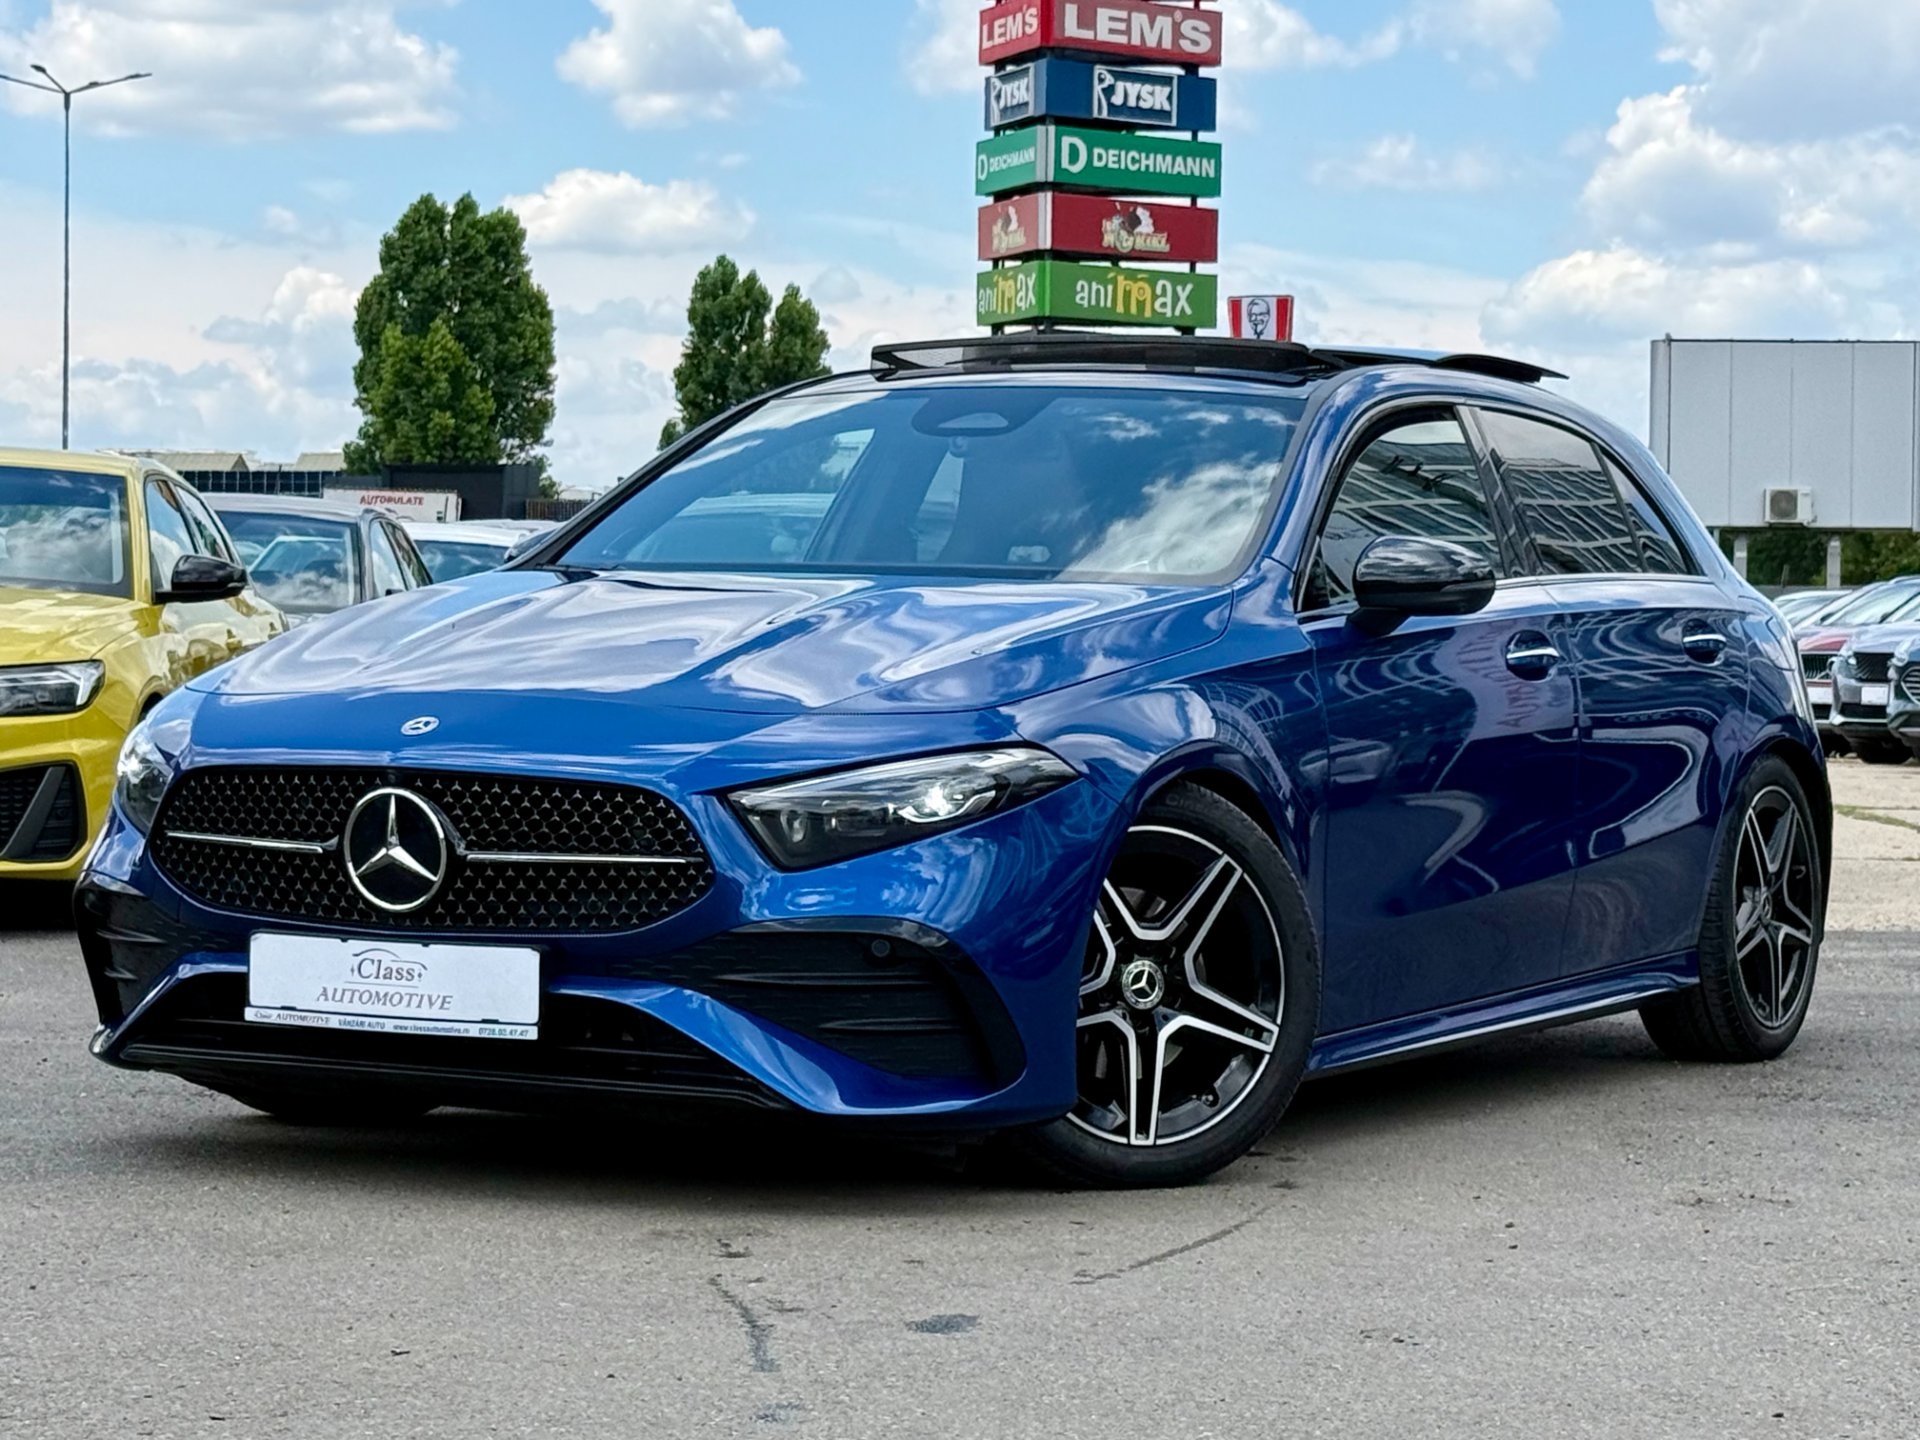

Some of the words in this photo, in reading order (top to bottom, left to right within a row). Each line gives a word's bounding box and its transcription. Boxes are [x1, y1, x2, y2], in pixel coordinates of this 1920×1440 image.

[982, 5, 1039, 50] LEM'S
[1063, 8, 1212, 54] LEM'S
[999, 77, 1029, 109] JYSK
[1110, 83, 1171, 111] JYSK
[989, 147, 1036, 173] DEICHMANN
[1092, 147, 1215, 178] DEICHMANN
[978, 271, 1036, 315] animax
[1075, 271, 1194, 317] animax
[357, 958, 415, 982] Class
[316, 986, 453, 1011] AUTOMOTIVE
[275, 1013, 331, 1025] AUTOMOTIVE
